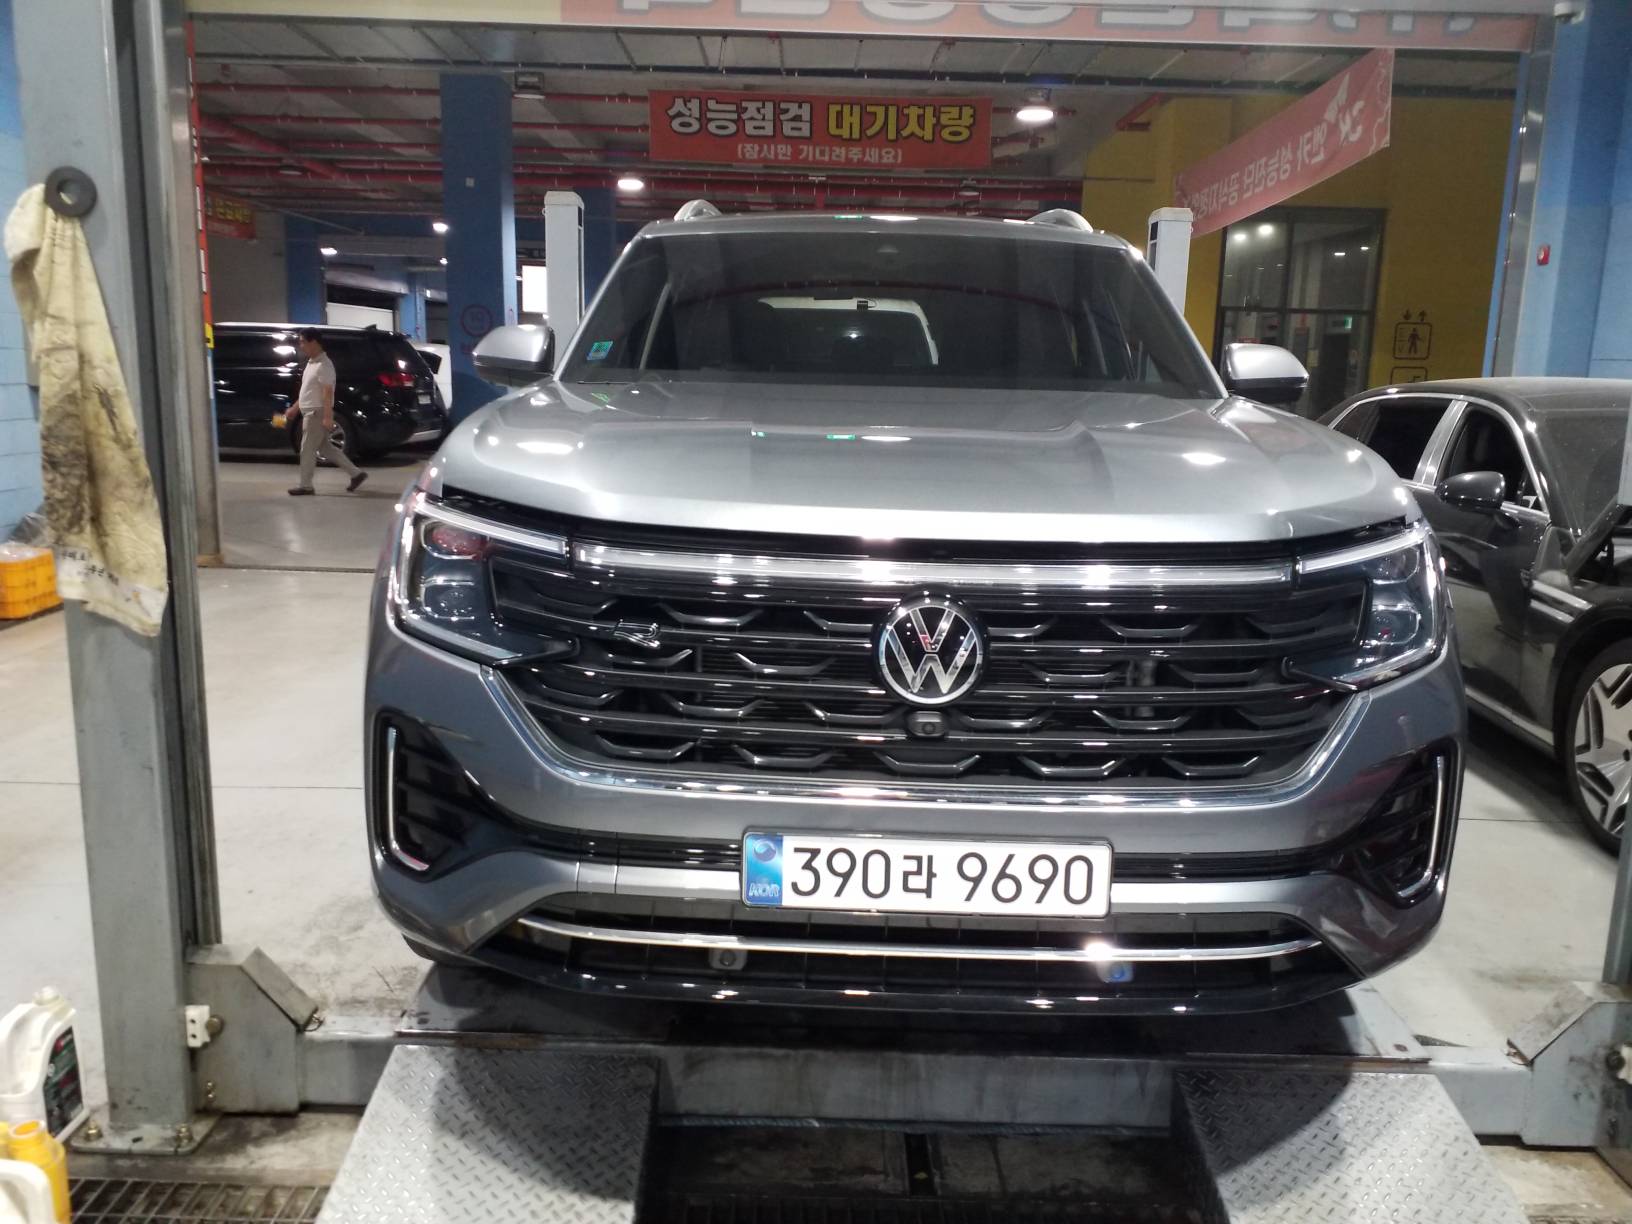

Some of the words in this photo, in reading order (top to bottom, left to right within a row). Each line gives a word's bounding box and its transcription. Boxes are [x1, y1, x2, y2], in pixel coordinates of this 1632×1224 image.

[667, 96, 812, 139] 성능점검
[827, 103, 976, 143] 대기차량
[737, 143, 793, 161] (잠시만
[799, 145, 903, 165] 기다려주세요)
[791, 847, 937, 899] 390라
[956, 851, 1095, 906] 9690
